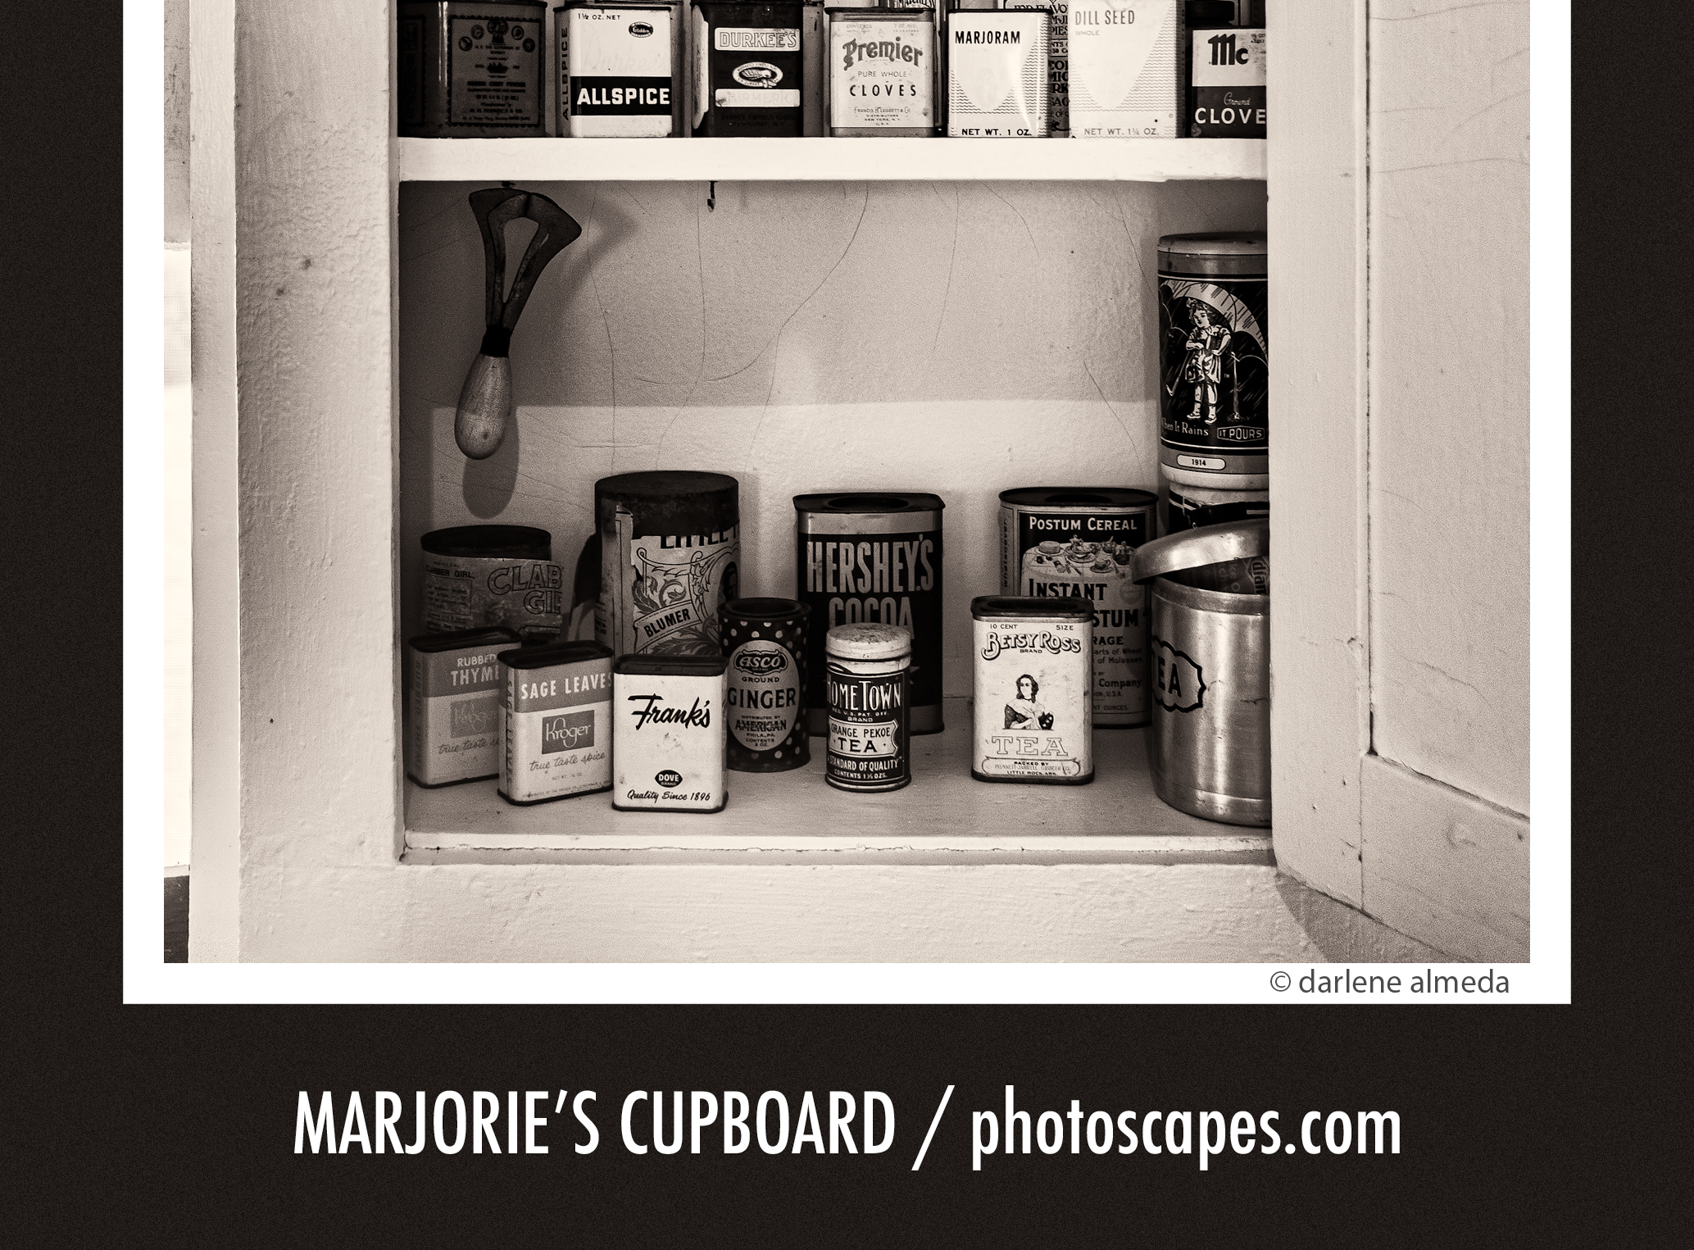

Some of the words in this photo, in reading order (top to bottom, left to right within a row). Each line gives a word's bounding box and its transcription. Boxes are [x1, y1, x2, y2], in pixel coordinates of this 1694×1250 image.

[1075, 10, 1100, 26] DILL
[1104, 9, 1135, 25] SEED
[719, 31, 798, 48] DURKEE'S
[954, 30, 1021, 45] MARJORAM
[842, 36, 924, 71] Premier
[858, 70, 877, 78] PURE
[881, 70, 908, 78] WHOLE
[577, 87, 671, 106] ALLSPICE
[849, 84, 917, 97] CLOVES
[961, 128, 980, 136] NET
[984, 128, 1001, 136] WT.
[1007, 128, 1012, 136] 1
[1084, 127, 1102, 136] NET
[1107, 127, 1124, 136] WT.
[1144, 127, 1160, 136] OZ.
[1181, 421, 1209, 437] Rains
[1228, 428, 1263, 440] POURS
[1191, 458, 1207, 467] 1914
[1029, 516, 1082, 531] POSTUM
[1087, 517, 1138, 531] CEREAL
[806, 534, 934, 594] HERSHEY'S
[1029, 578, 1108, 601] INSTANT
[643, 607, 691, 638] BLUMER
[1092, 608, 1139, 628] STUM
[981, 631, 1040, 661] BETSY
[1038, 630, 1082, 655] ROSS
[457, 653, 497, 668] RUBBED
[739, 656, 781, 668] ASCO
[1098, 678, 1143, 689] Company
[1158, 654, 1183, 698] EA
[521, 680, 557, 700] SAGE
[727, 687, 797, 709] GINGER
[627, 693, 711, 731] Frank's
[545, 717, 592, 749] Kroger
[735, 719, 787, 732] AMERICAN
[831, 722, 858, 738] ORANGE
[863, 727, 891, 738] PEKOE
[838, 737, 878, 753] TEA
[991, 735, 1069, 757] TEA
[529, 760, 551, 771] true
[554, 754, 579, 768] taste
[580, 750, 606, 764] spice
[858, 761, 868, 772] OF
[658, 773, 680, 782] DOVE
[626, 789, 660, 803] Quality
[661, 790, 688, 801] Since
[689, 792, 711, 801] 1896
